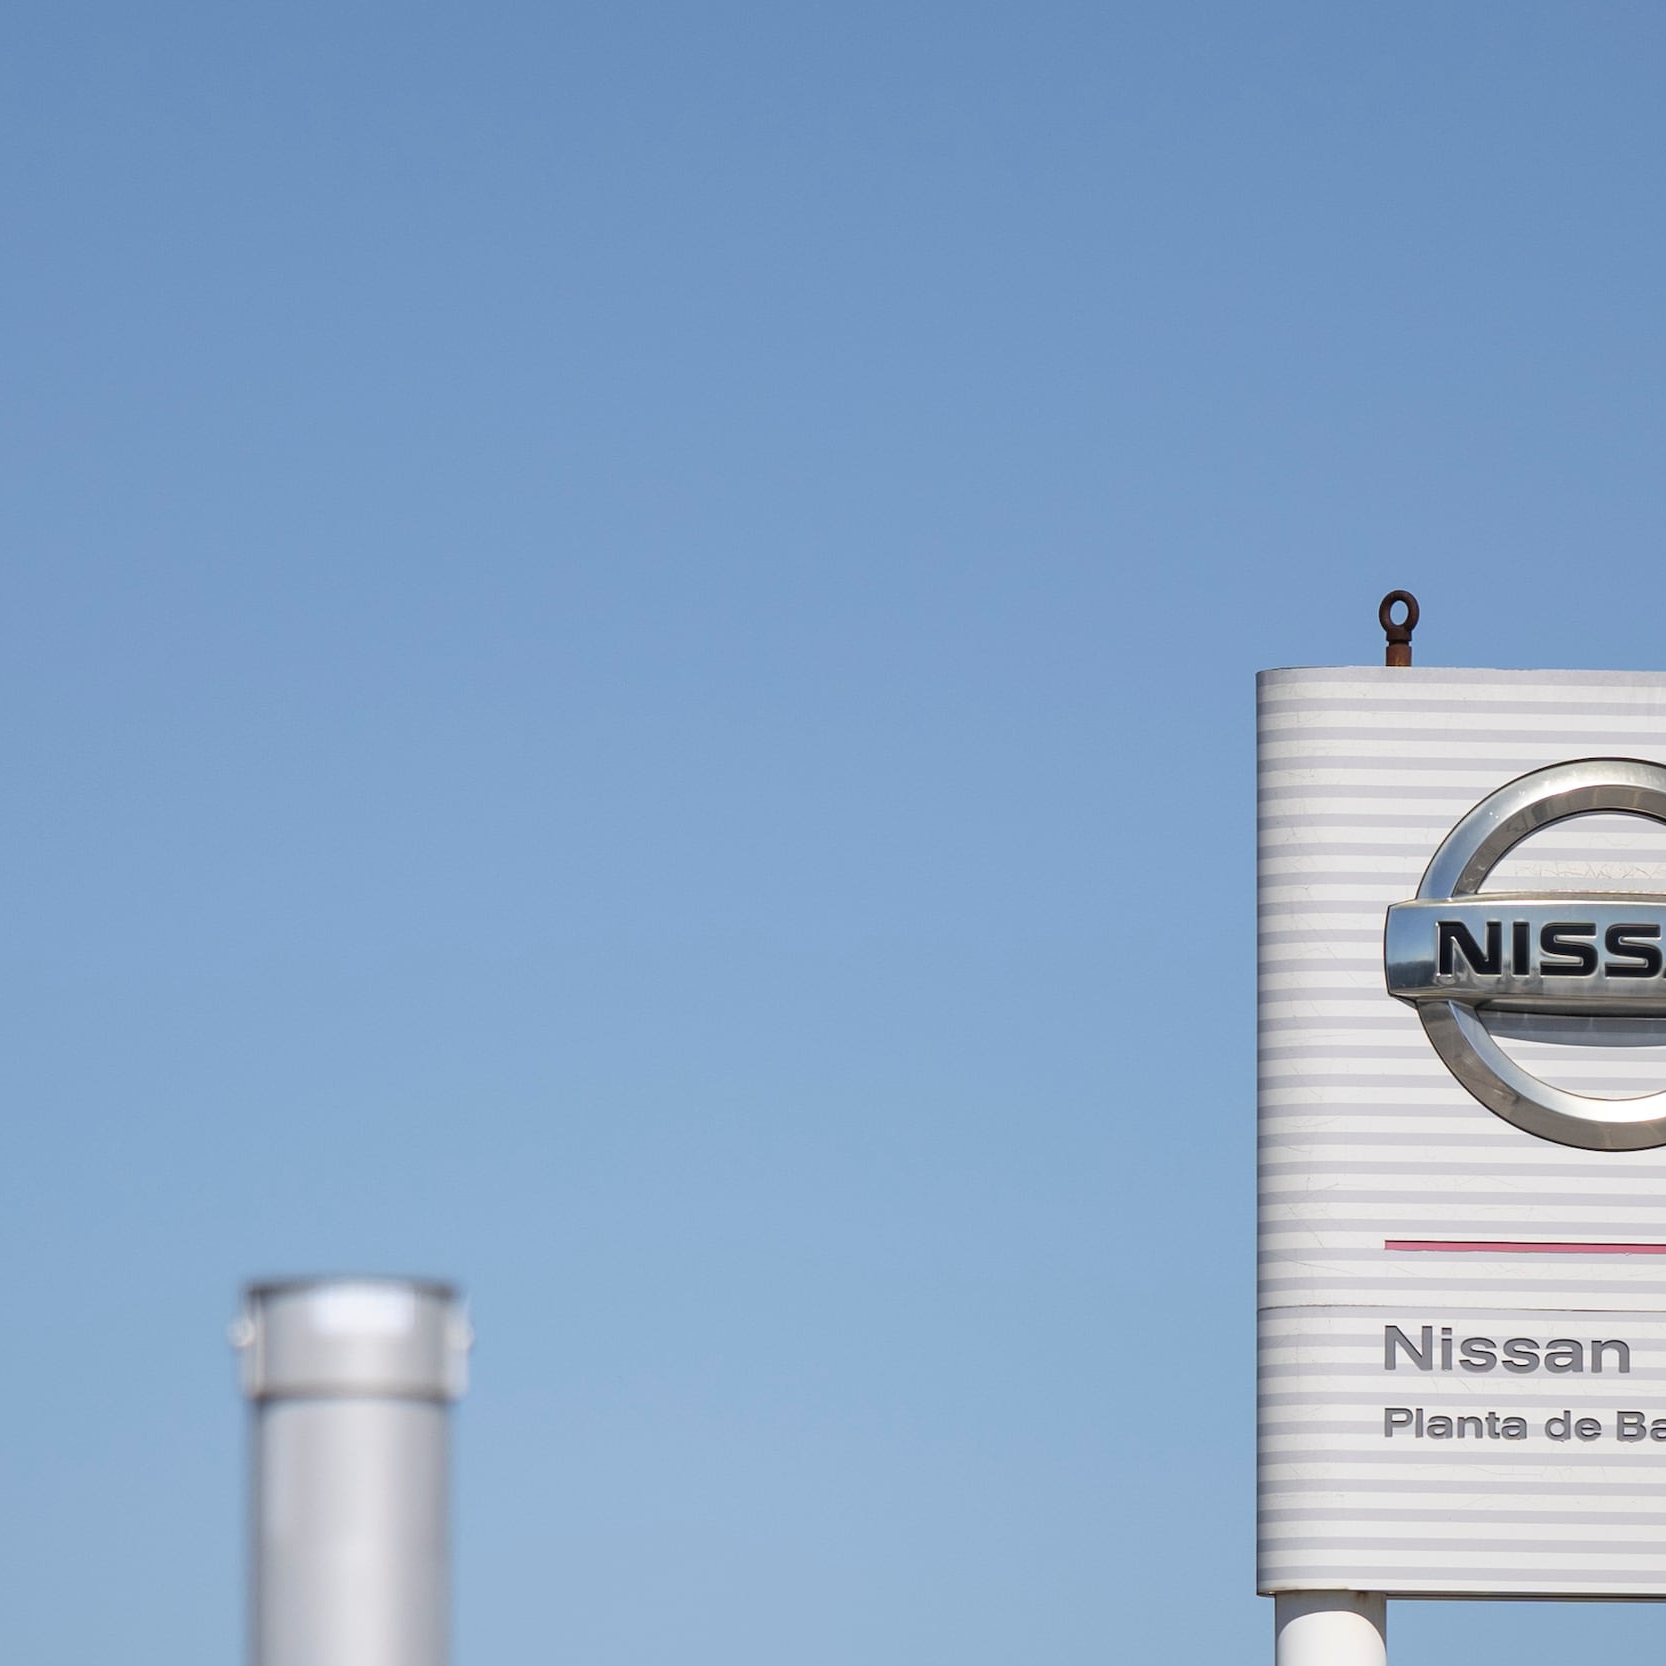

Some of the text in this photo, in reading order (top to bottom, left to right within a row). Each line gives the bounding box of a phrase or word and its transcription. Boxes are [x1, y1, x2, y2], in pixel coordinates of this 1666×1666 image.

[1384, 1324, 1631, 1374] Nissan
[1383, 1407, 1528, 1441] Planta
[1544, 1410, 1602, 1443] de
